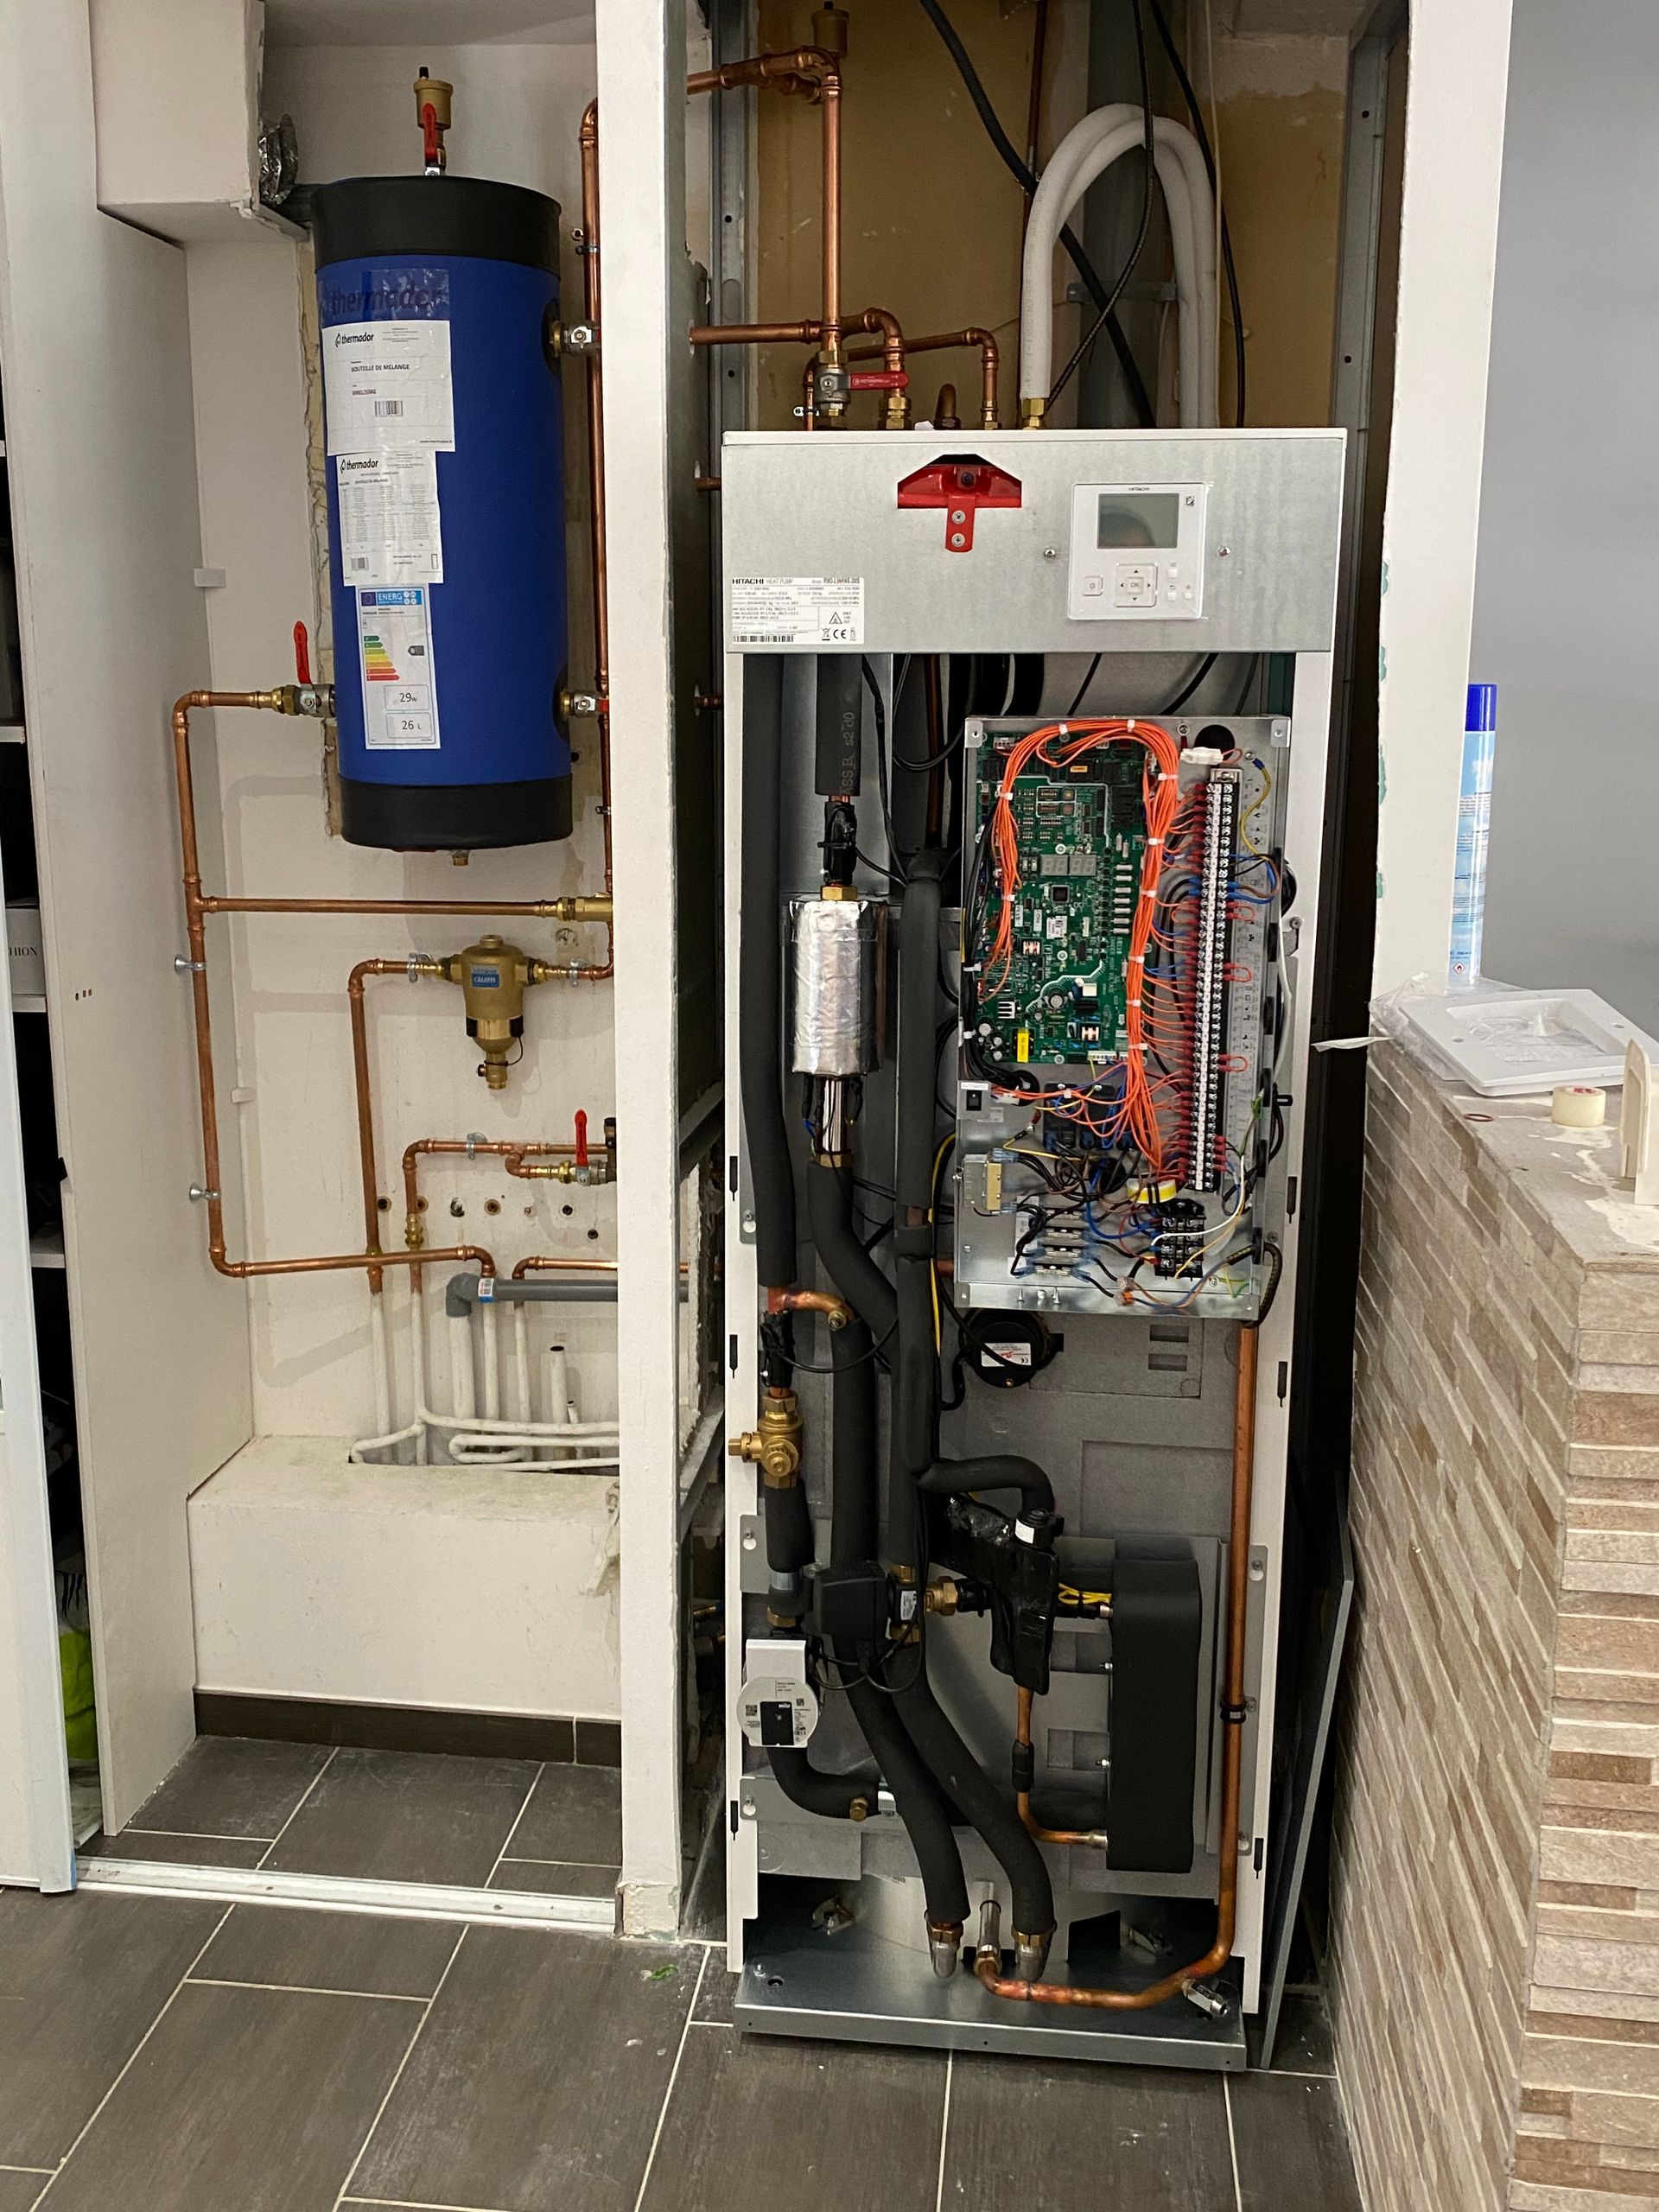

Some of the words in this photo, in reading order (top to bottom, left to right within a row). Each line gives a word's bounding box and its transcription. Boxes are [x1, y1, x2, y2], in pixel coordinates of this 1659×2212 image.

[341, 332, 374, 345] thermador
[346, 458, 378, 470] thermador
[378, 592, 403, 601] ENERG
[402, 720, 415, 730] 26
